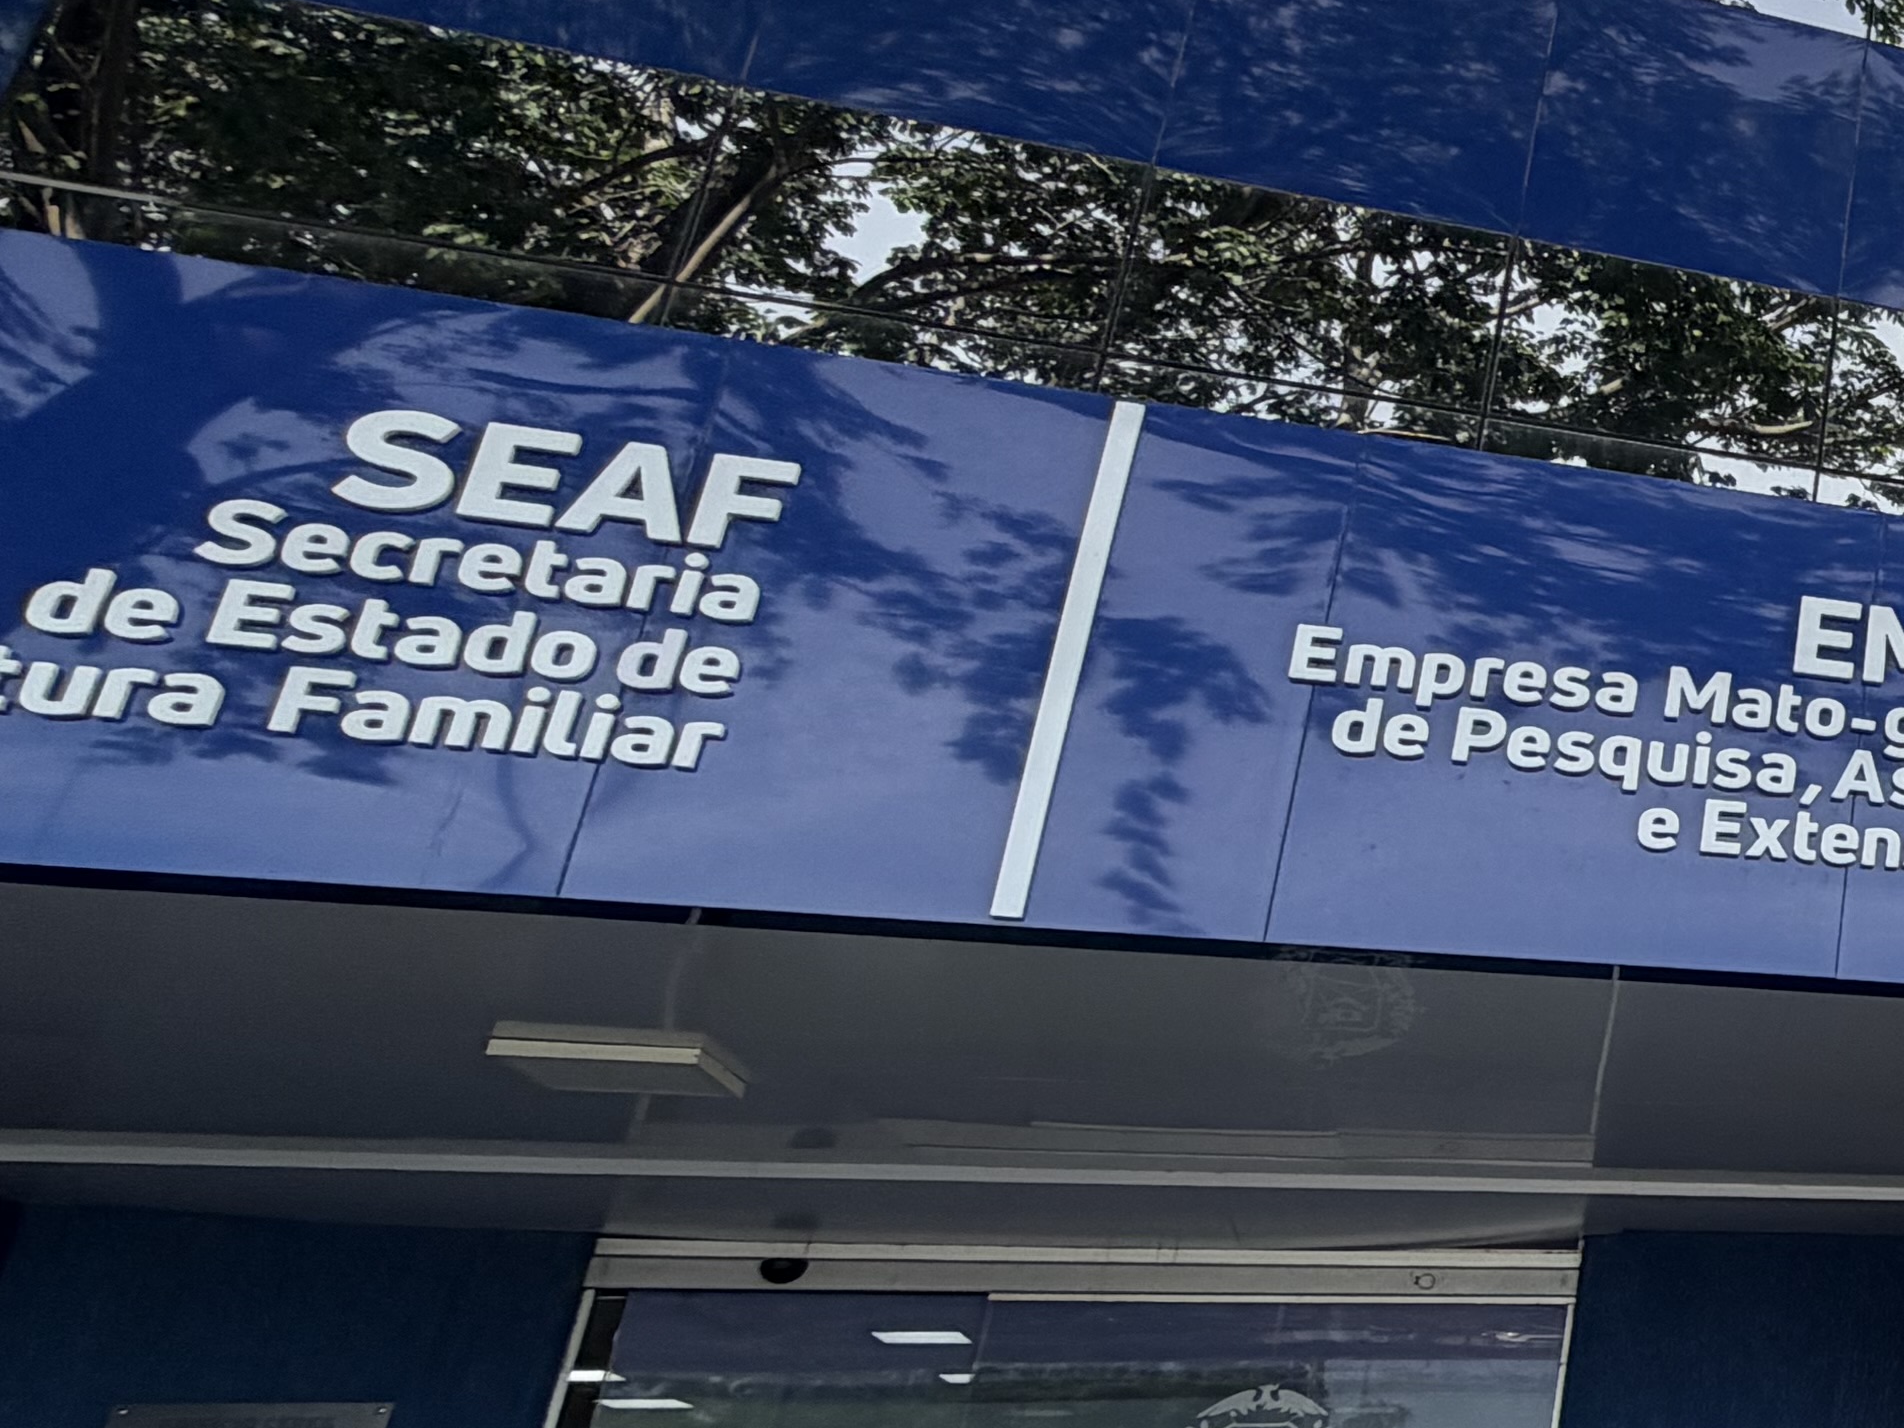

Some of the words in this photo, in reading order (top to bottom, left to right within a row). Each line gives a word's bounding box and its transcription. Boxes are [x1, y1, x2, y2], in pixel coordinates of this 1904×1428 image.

[332, 410, 801, 548] SEAF
[194, 499, 760, 622] Secretaria
[25, 568, 178, 640] de
[206, 579, 597, 680] Estado
[616, 628, 741, 694] de
[1288, 623, 1639, 714] Empresa
[267, 666, 726, 769] Familiar
[1331, 697, 1429, 757] de
[1451, 706, 1822, 806] Pesquisa,
[1637, 807, 1681, 850] e
